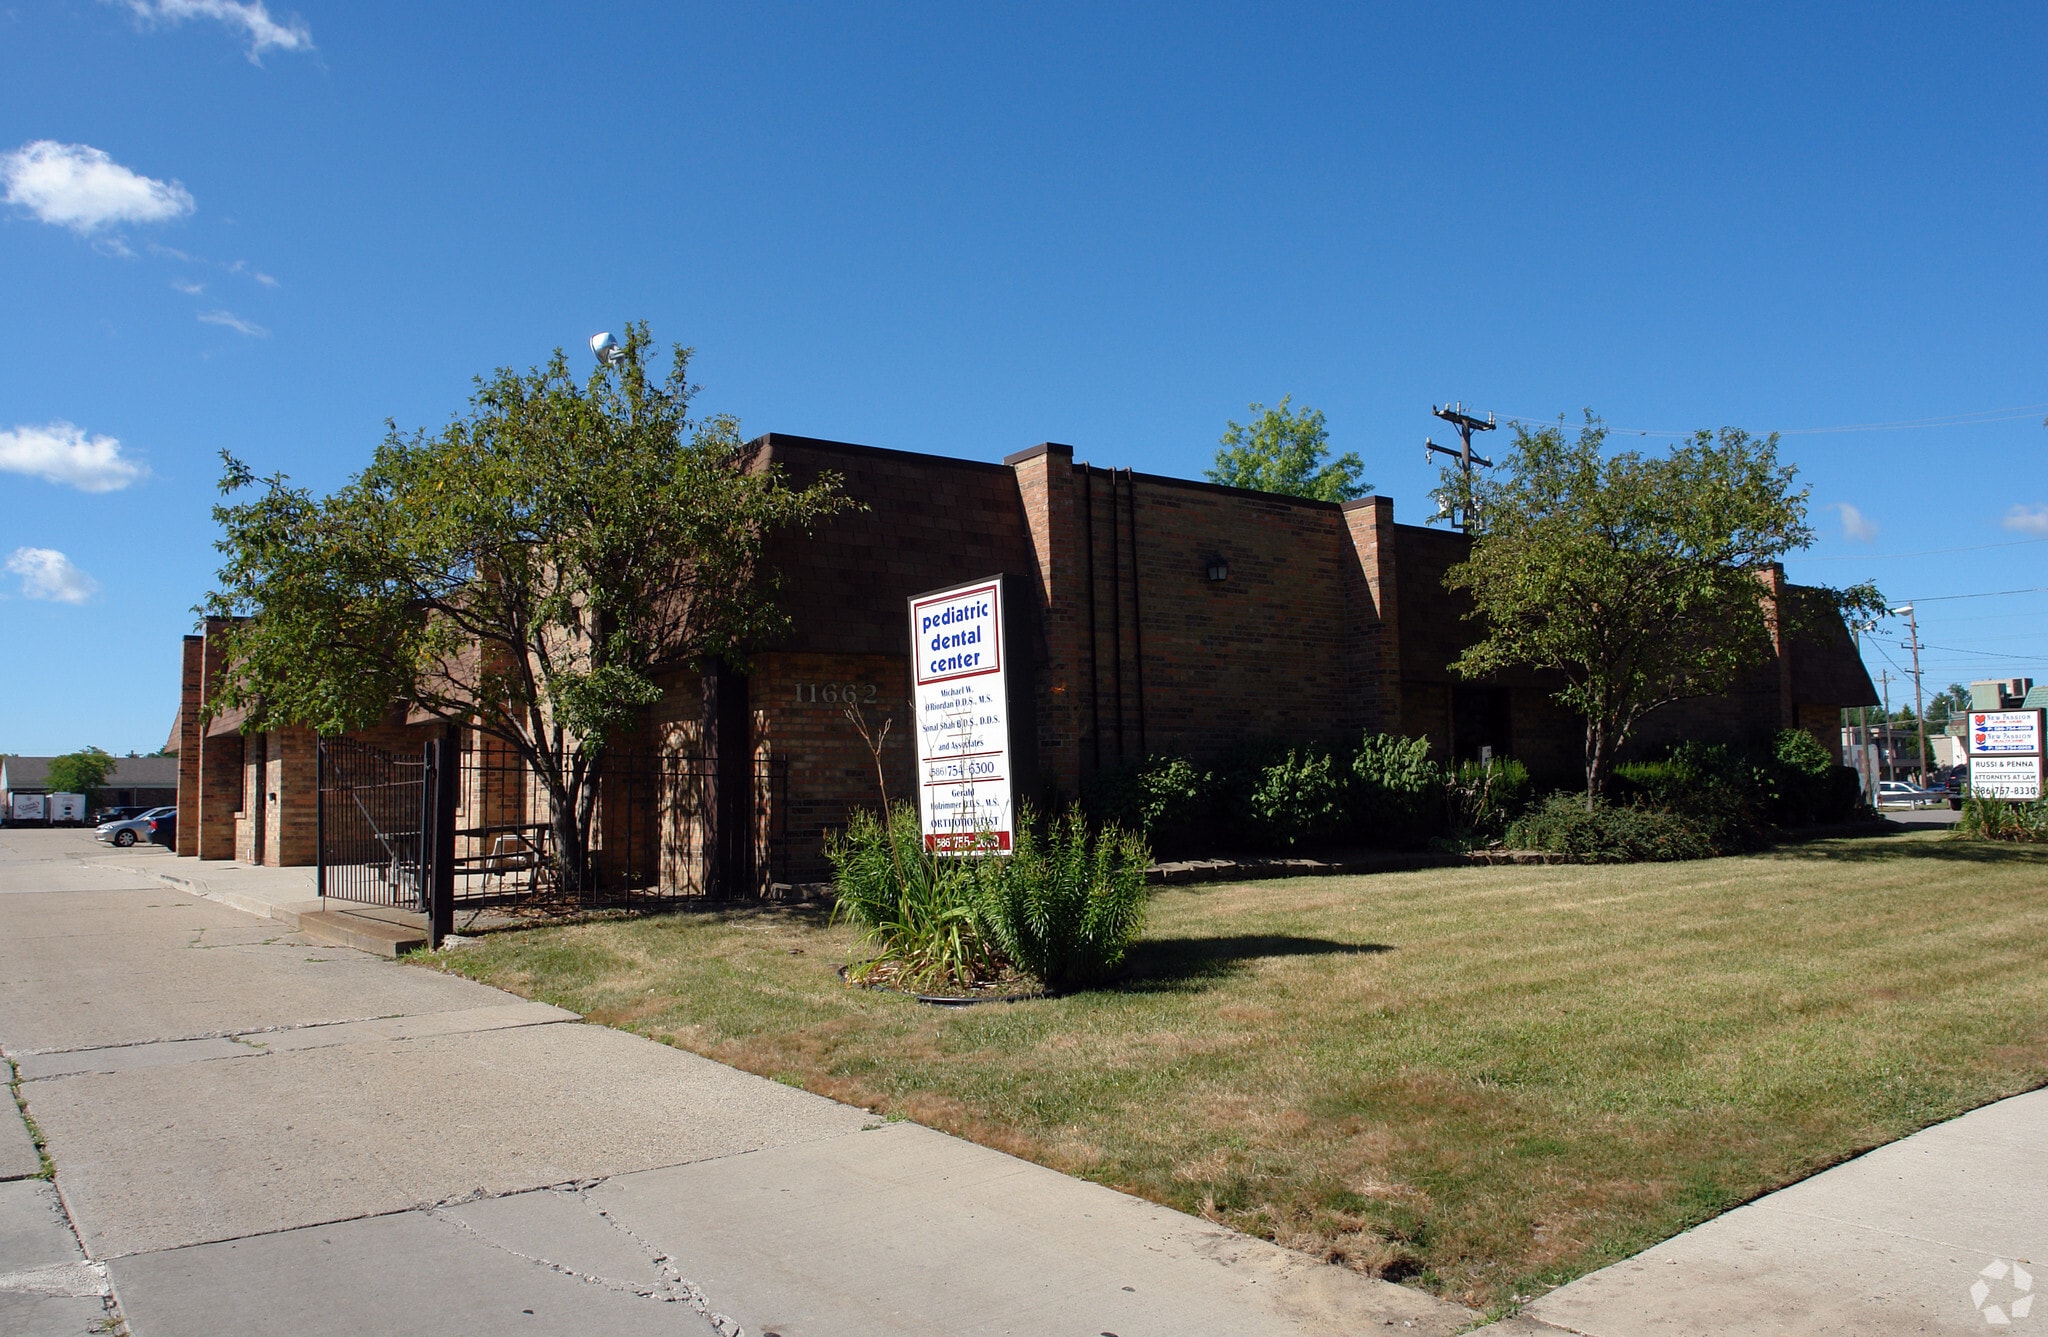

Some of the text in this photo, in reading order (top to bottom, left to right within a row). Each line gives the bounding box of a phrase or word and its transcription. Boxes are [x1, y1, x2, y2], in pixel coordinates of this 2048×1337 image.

[923, 600, 988, 634] pediatric
[931, 625, 981, 651] dental
[930, 652, 980, 673] center
[794, 681, 878, 704] 11662
[940, 685, 974, 697] Michael W.
[978, 694, 993, 704] M.S.
[922, 714, 1001, 732] Sonal Shah BD.S., D.D.S.
[938, 742, 950, 751] and
[2006, 760, 2034, 768] PENNA
[951, 787, 975, 797] Gerald
[985, 798, 1000, 807] M.S.
